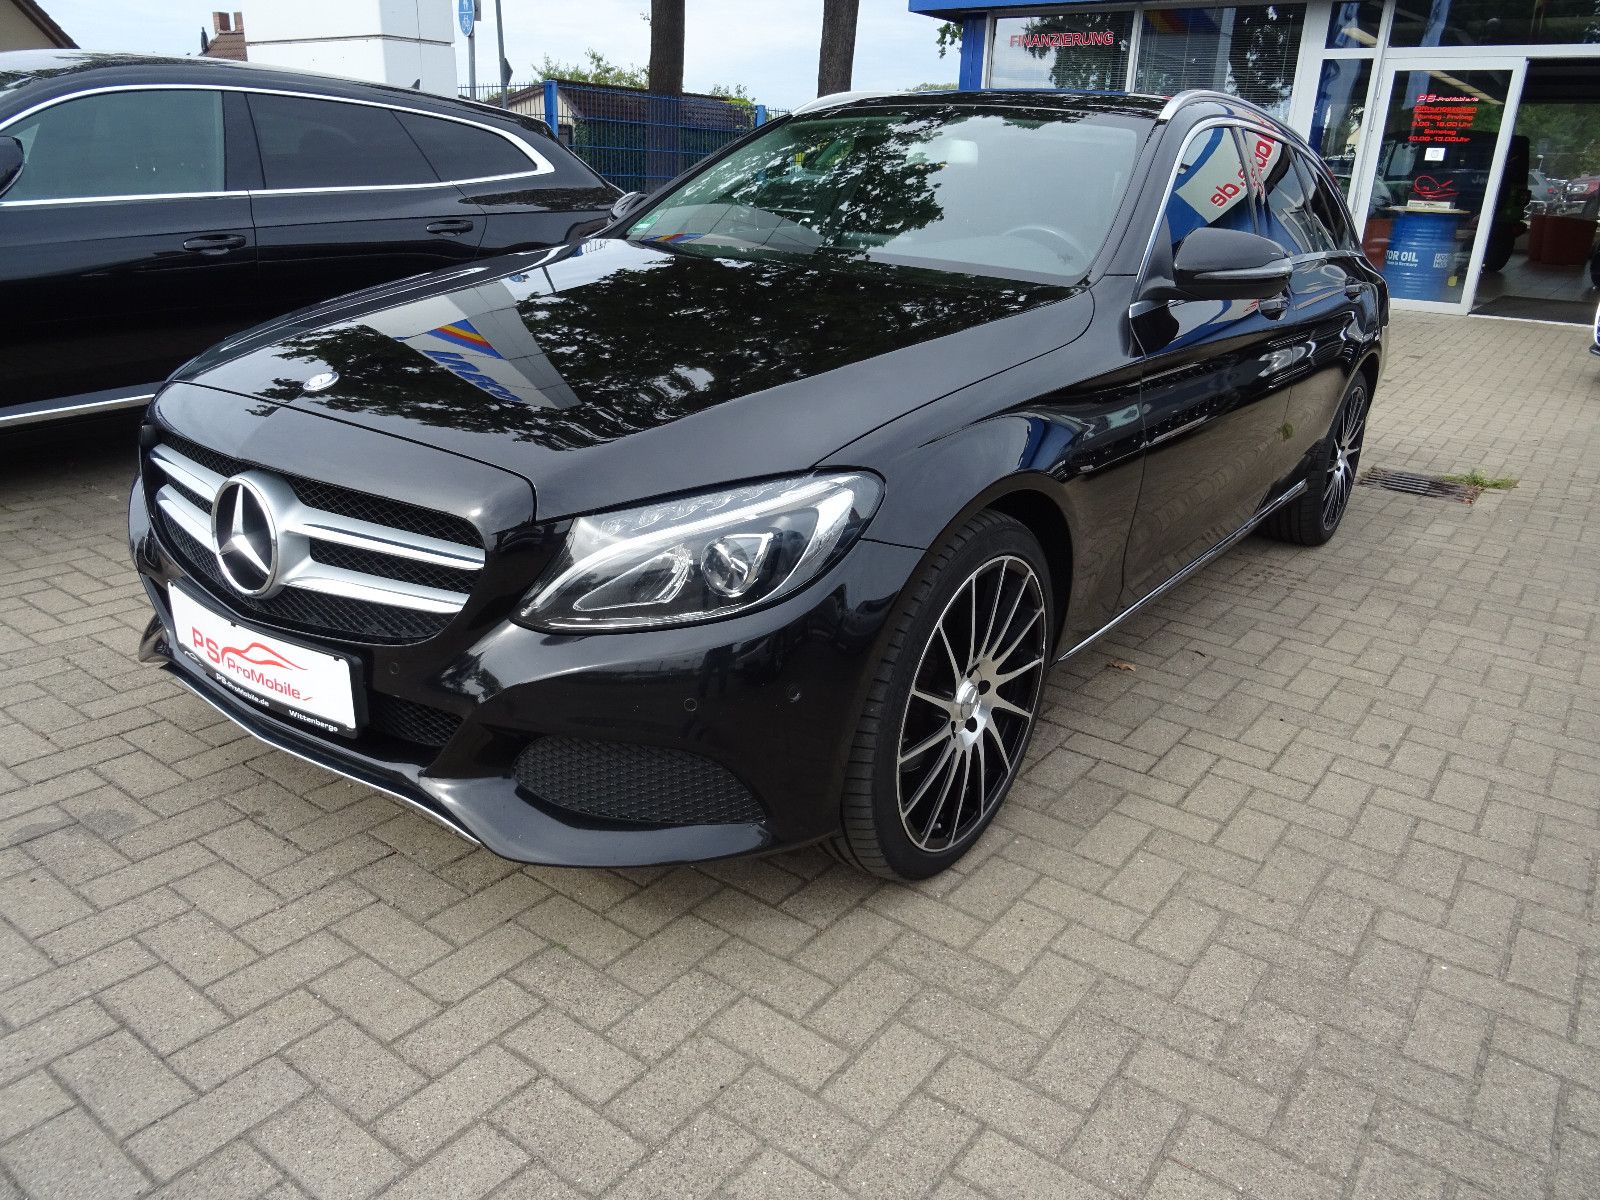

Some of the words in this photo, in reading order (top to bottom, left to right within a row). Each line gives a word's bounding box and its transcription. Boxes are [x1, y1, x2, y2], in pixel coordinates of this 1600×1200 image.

[1010, 31, 1114, 48] FINANZIERUNG
[1400, 251, 1419, 263] OIL
[191, 626, 221, 664] PS
[226, 657, 301, 700] ProMobile
[288, 708, 339, 733] Wittenberge
